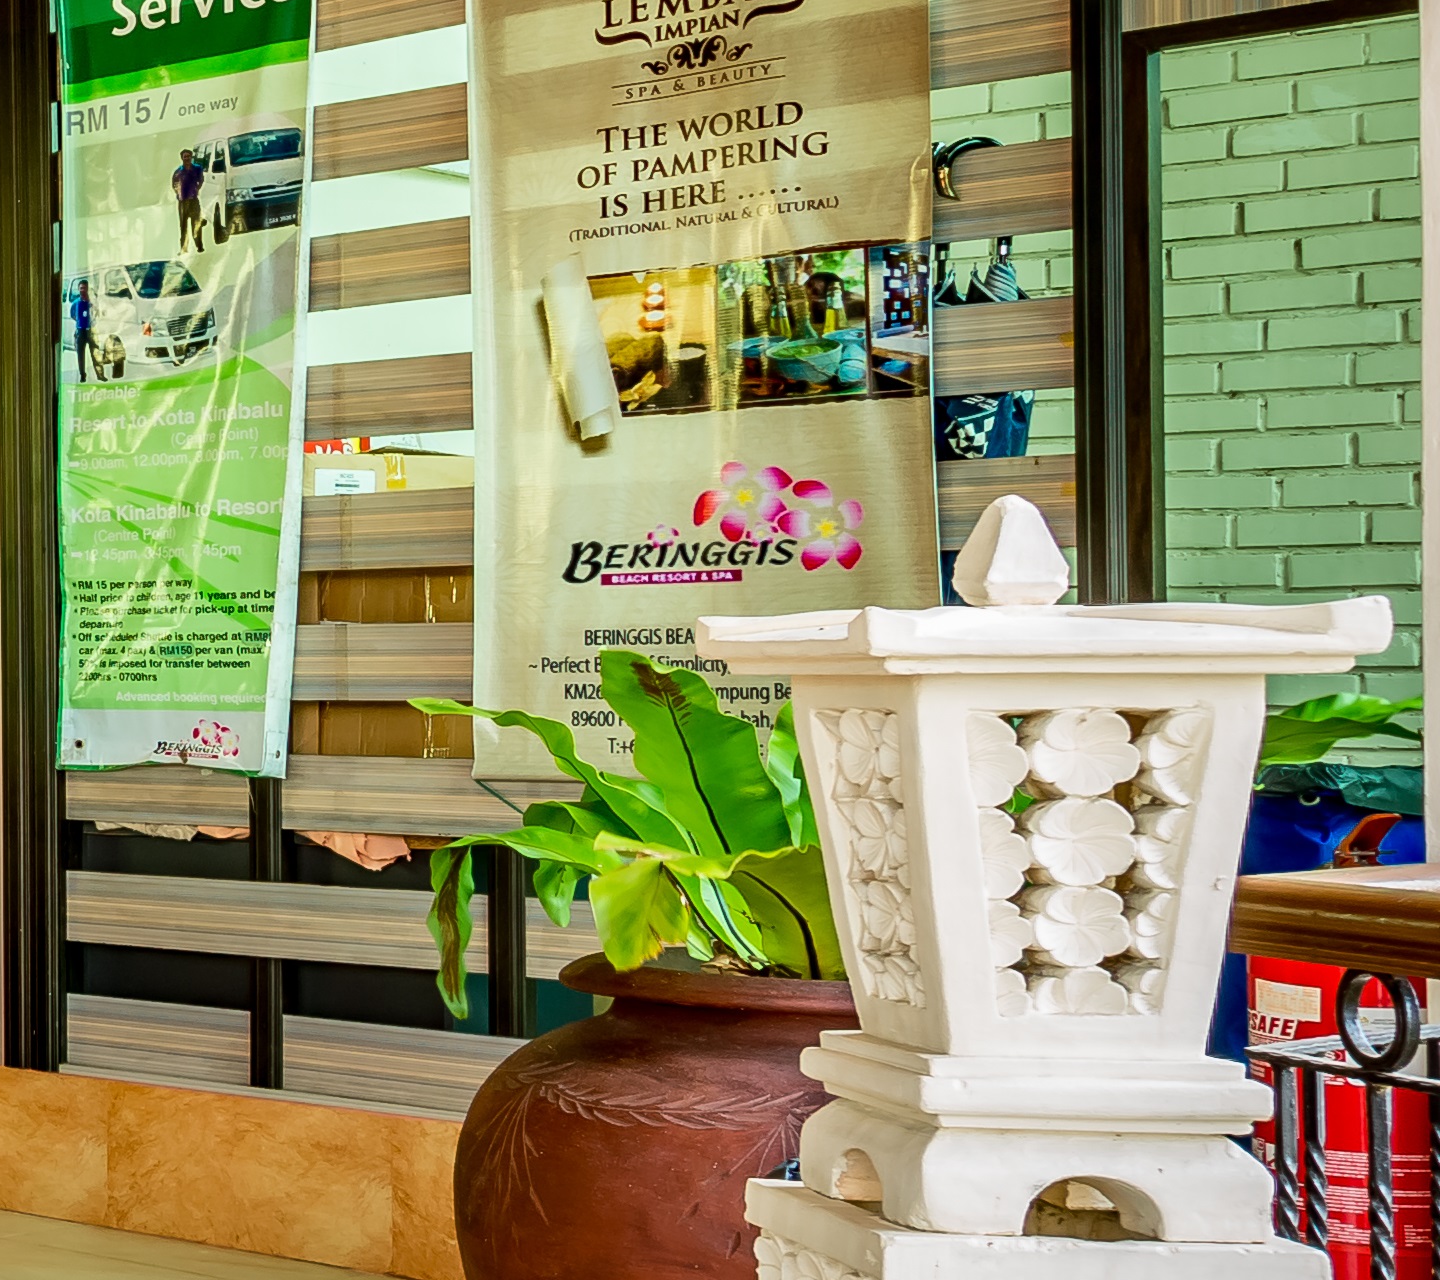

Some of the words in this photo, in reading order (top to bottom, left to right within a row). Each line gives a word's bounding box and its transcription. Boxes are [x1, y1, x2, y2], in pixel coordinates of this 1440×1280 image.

[654, 9, 740, 42] IMPIAN
[626, 84, 662, 100] SPA
[673, 80, 686, 92] &
[697, 64, 772, 88] BEAUTY
[66, 104, 108, 136] RM
[120, 97, 151, 126] 15
[159, 92, 170, 120] /
[178, 102, 205, 117] one
[210, 96, 238, 116] way
[596, 122, 668, 154] THE
[679, 100, 803, 142] WORLD
[577, 162, 618, 189] OF
[630, 131, 830, 182] PAMPERING
[600, 193, 628, 219] IS
[642, 180, 726, 214] HERE
[742, 206, 753, 219] &
[68, 385, 140, 403] Timetable:
[70, 413, 126, 433] Resort
[130, 412, 149, 429] to
[154, 409, 195, 426] Kota
[201, 401, 283, 422] Kinabalu
[71, 508, 110, 523] Kota
[116, 503, 190, 521] Kinabalu
[195, 502, 210, 518] to
[94, 530, 138, 544] (Centre
[562, 538, 798, 584] BERINGGIS
[78, 581, 93, 589] RM
[96, 580, 107, 589] 15
[110, 581, 125, 591] per
[176, 578, 192, 589] way
[612, 574, 649, 584] BEACH
[652, 572, 697, 583] RESORT
[701, 572, 708, 581] &
[711, 572, 733, 581] SPA
[80, 594, 97, 602] Half
[175, 592, 191, 602] age
[194, 591, 204, 600] 11
[207, 592, 237, 604] years
[240, 590, 260, 599] and
[195, 604, 235, 616] pick-up
[238, 604, 248, 613] at
[78, 632, 92, 641] Off
[175, 632, 184, 641] is
[187, 632, 228, 644] charged
[231, 632, 242, 640] at
[584, 628, 662, 646] BERINGGIS
[79, 647, 94, 655] car
[149, 646, 156, 654] &
[159, 646, 192, 655] RM150
[196, 646, 211, 656] per
[214, 646, 233, 654] van
[149, 659, 162, 668] for
[165, 659, 204, 668] transfer
[207, 659, 250, 668] between
[541, 656, 590, 673] Perfect
[119, 672, 157, 682] 0700hrs
[116, 692, 170, 702] Advanced
[174, 692, 217, 704] booking
[714, 686, 770, 704] mpung
[571, 710, 614, 727] 89600
[154, 740, 223, 755] BERINGGIS
